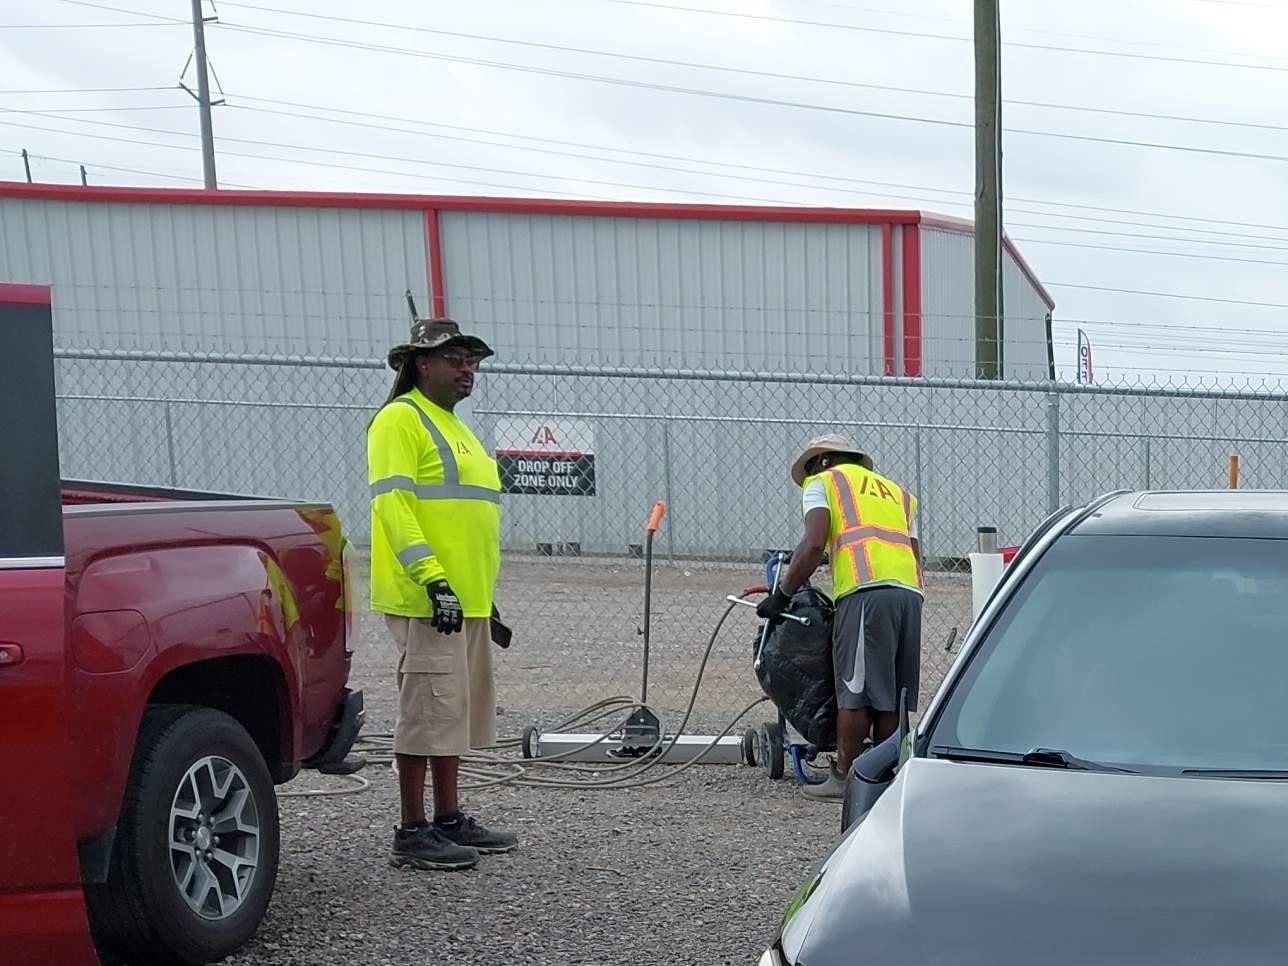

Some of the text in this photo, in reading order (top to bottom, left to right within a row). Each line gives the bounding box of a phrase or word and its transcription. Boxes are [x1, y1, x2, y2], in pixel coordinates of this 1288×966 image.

[518, 460, 575, 474] DROP OFF
[513, 474, 579, 488] ZONE ONLY
